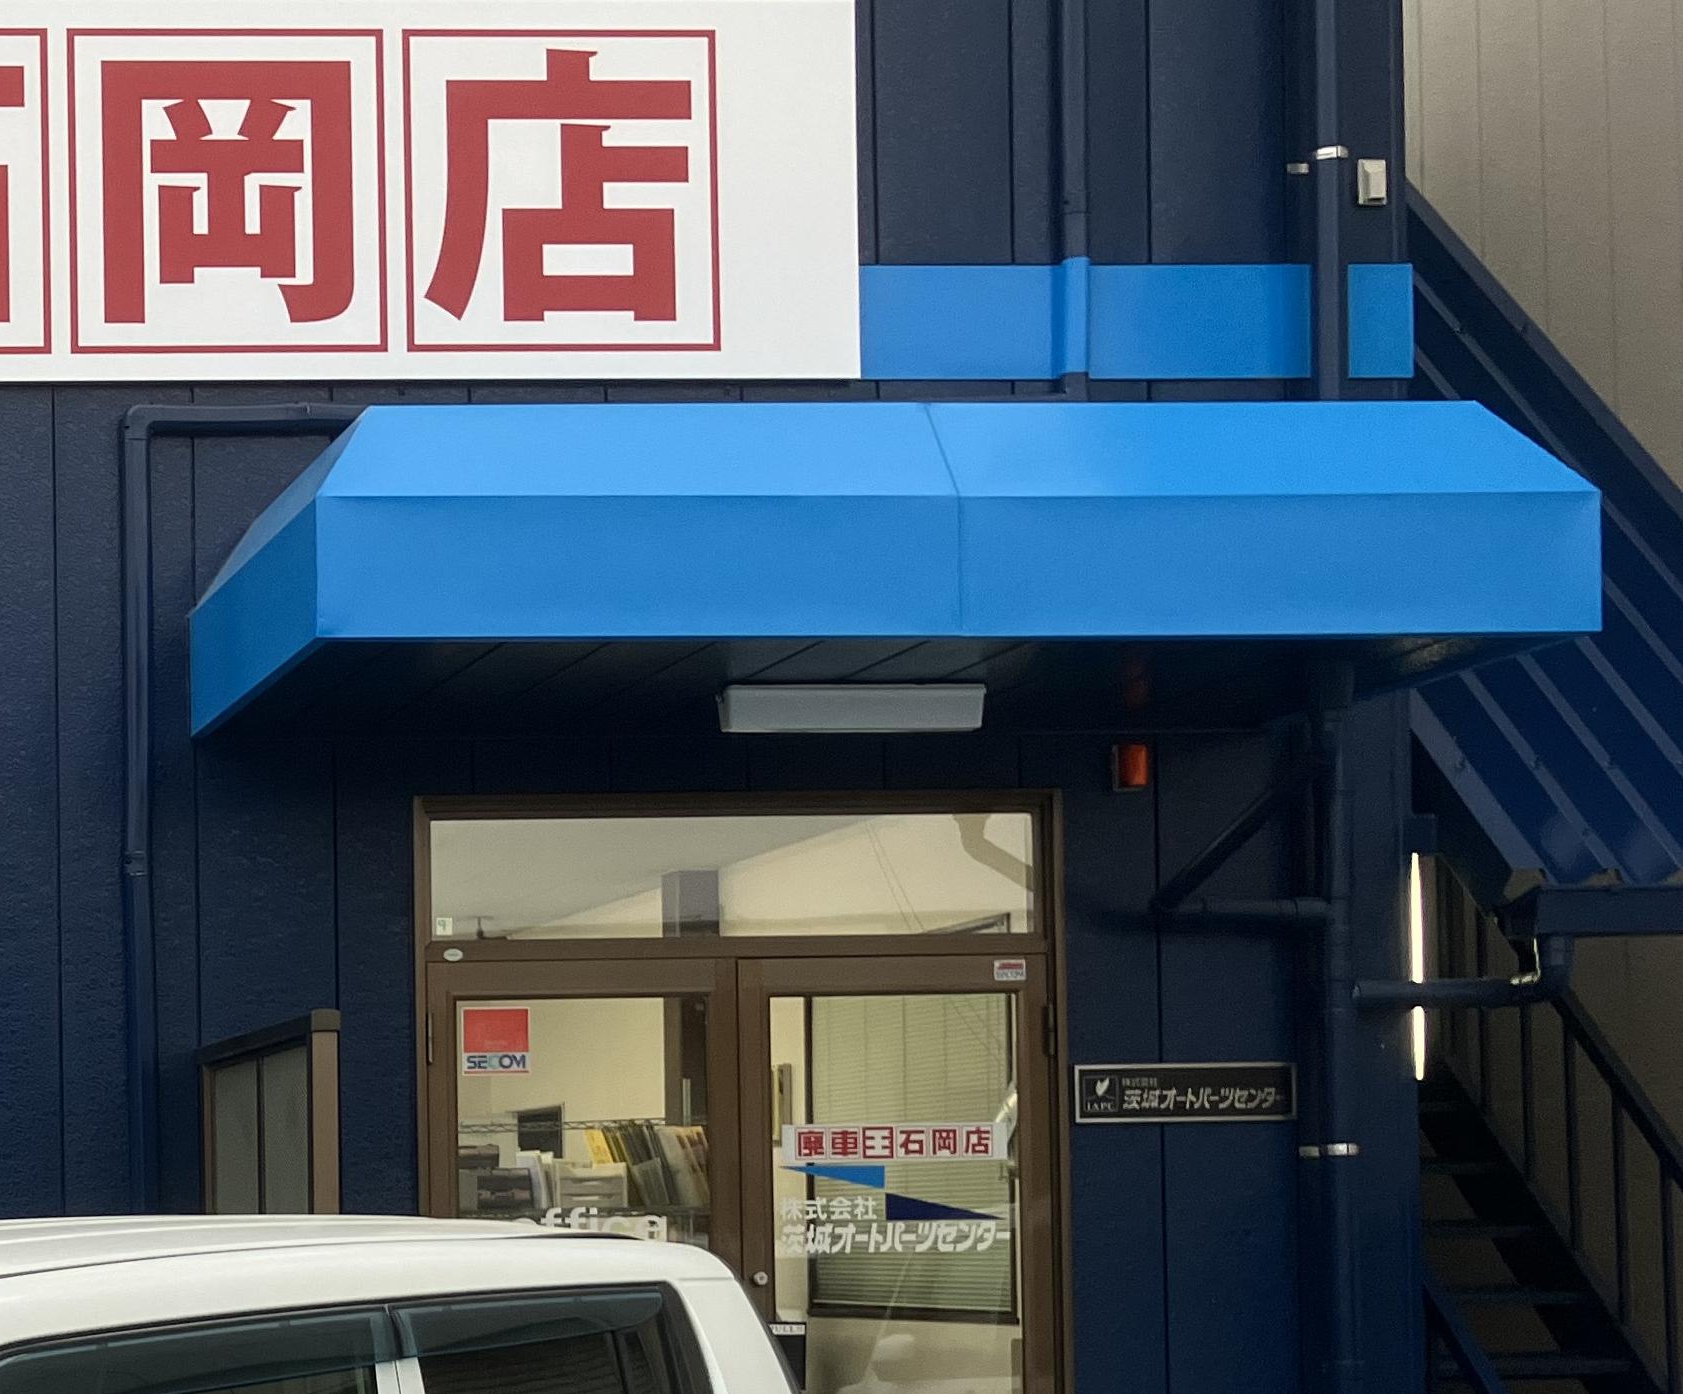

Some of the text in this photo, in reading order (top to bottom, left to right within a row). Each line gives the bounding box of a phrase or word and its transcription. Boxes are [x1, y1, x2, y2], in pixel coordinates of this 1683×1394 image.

[466, 1053, 526, 1070] SECOM
[1122, 1087, 1284, 1111] 茨城オートパーツセンター
[796, 1126, 991, 1158] 廃車王石岡店
[780, 1196, 879, 1221] 株式会社
[781, 1220, 1011, 1254] 茨城オートパーツセンター
